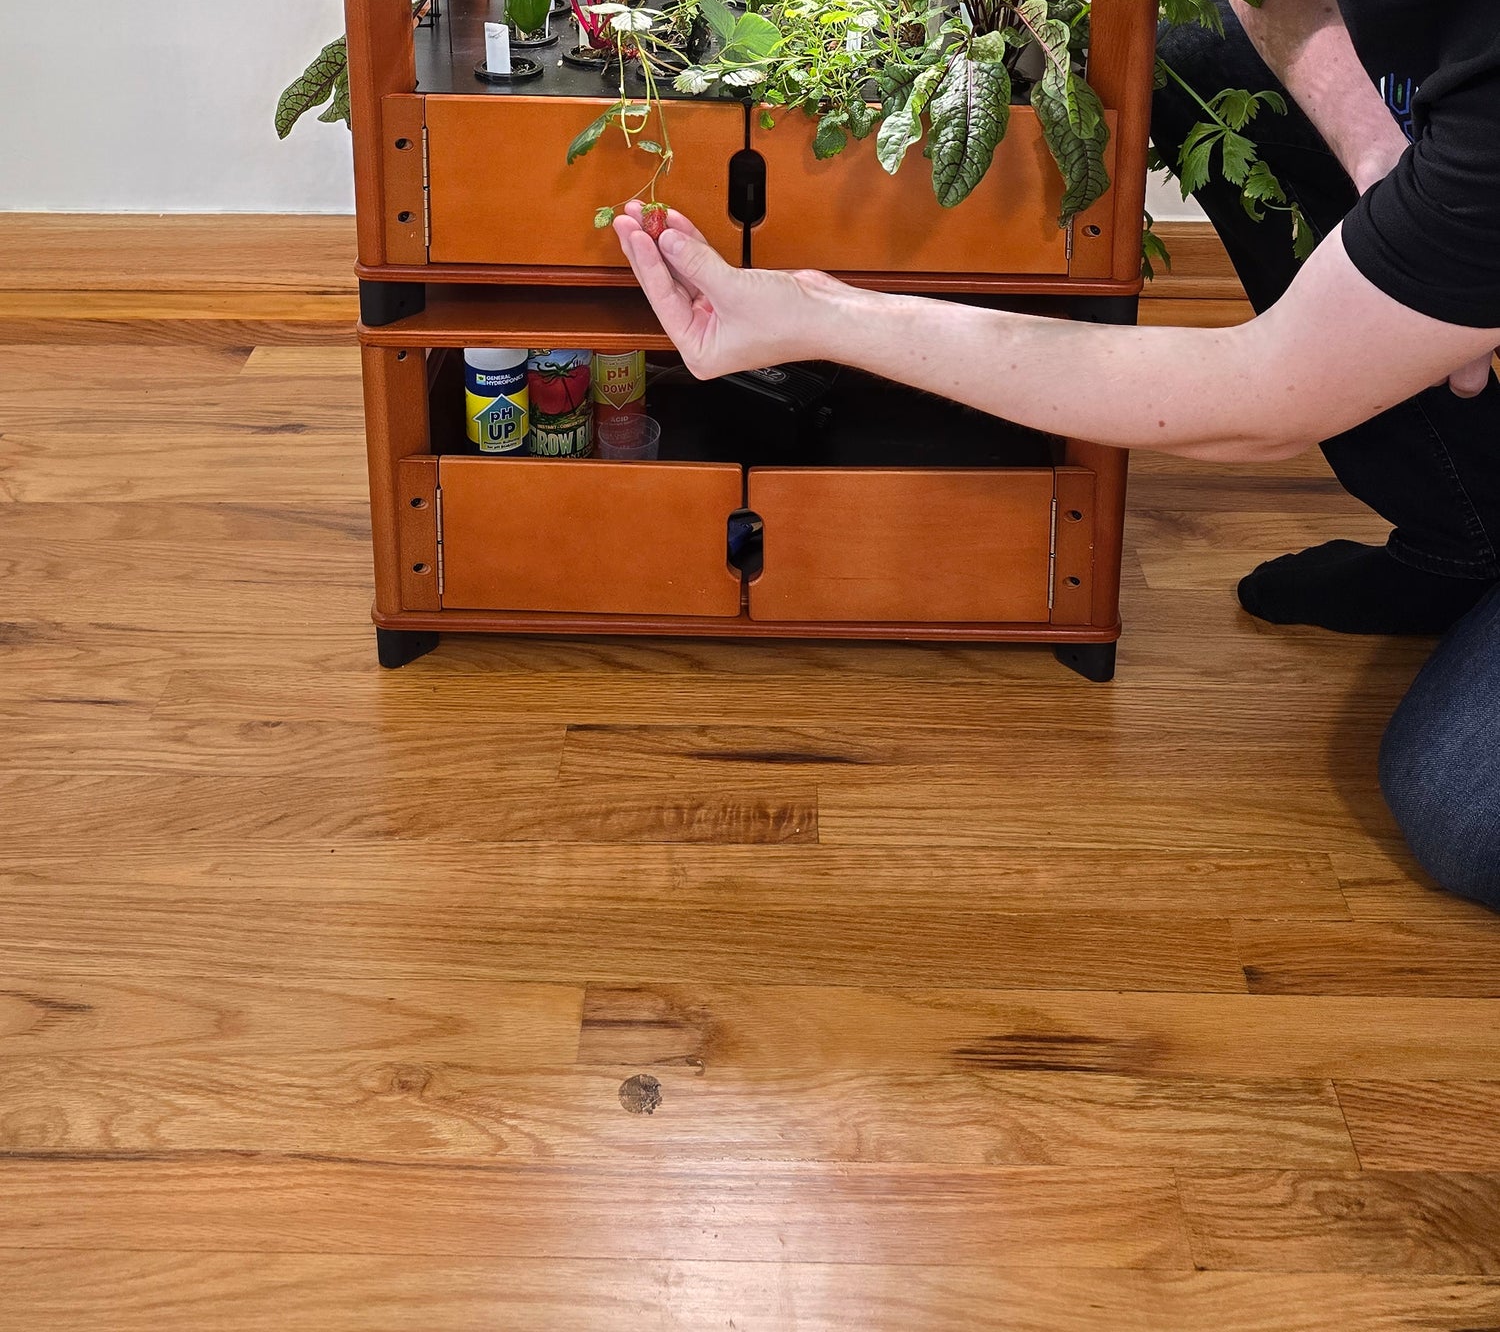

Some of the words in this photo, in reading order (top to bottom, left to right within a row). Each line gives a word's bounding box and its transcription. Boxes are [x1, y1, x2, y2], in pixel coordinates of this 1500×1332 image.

[486, 373, 524, 386] HYDROPONICS
[606, 366, 629, 381] pH
[603, 381, 634, 394] DOWN
[490, 406, 513, 423] pH
[611, 415, 629, 423] ACID
[488, 422, 516, 440] UP
